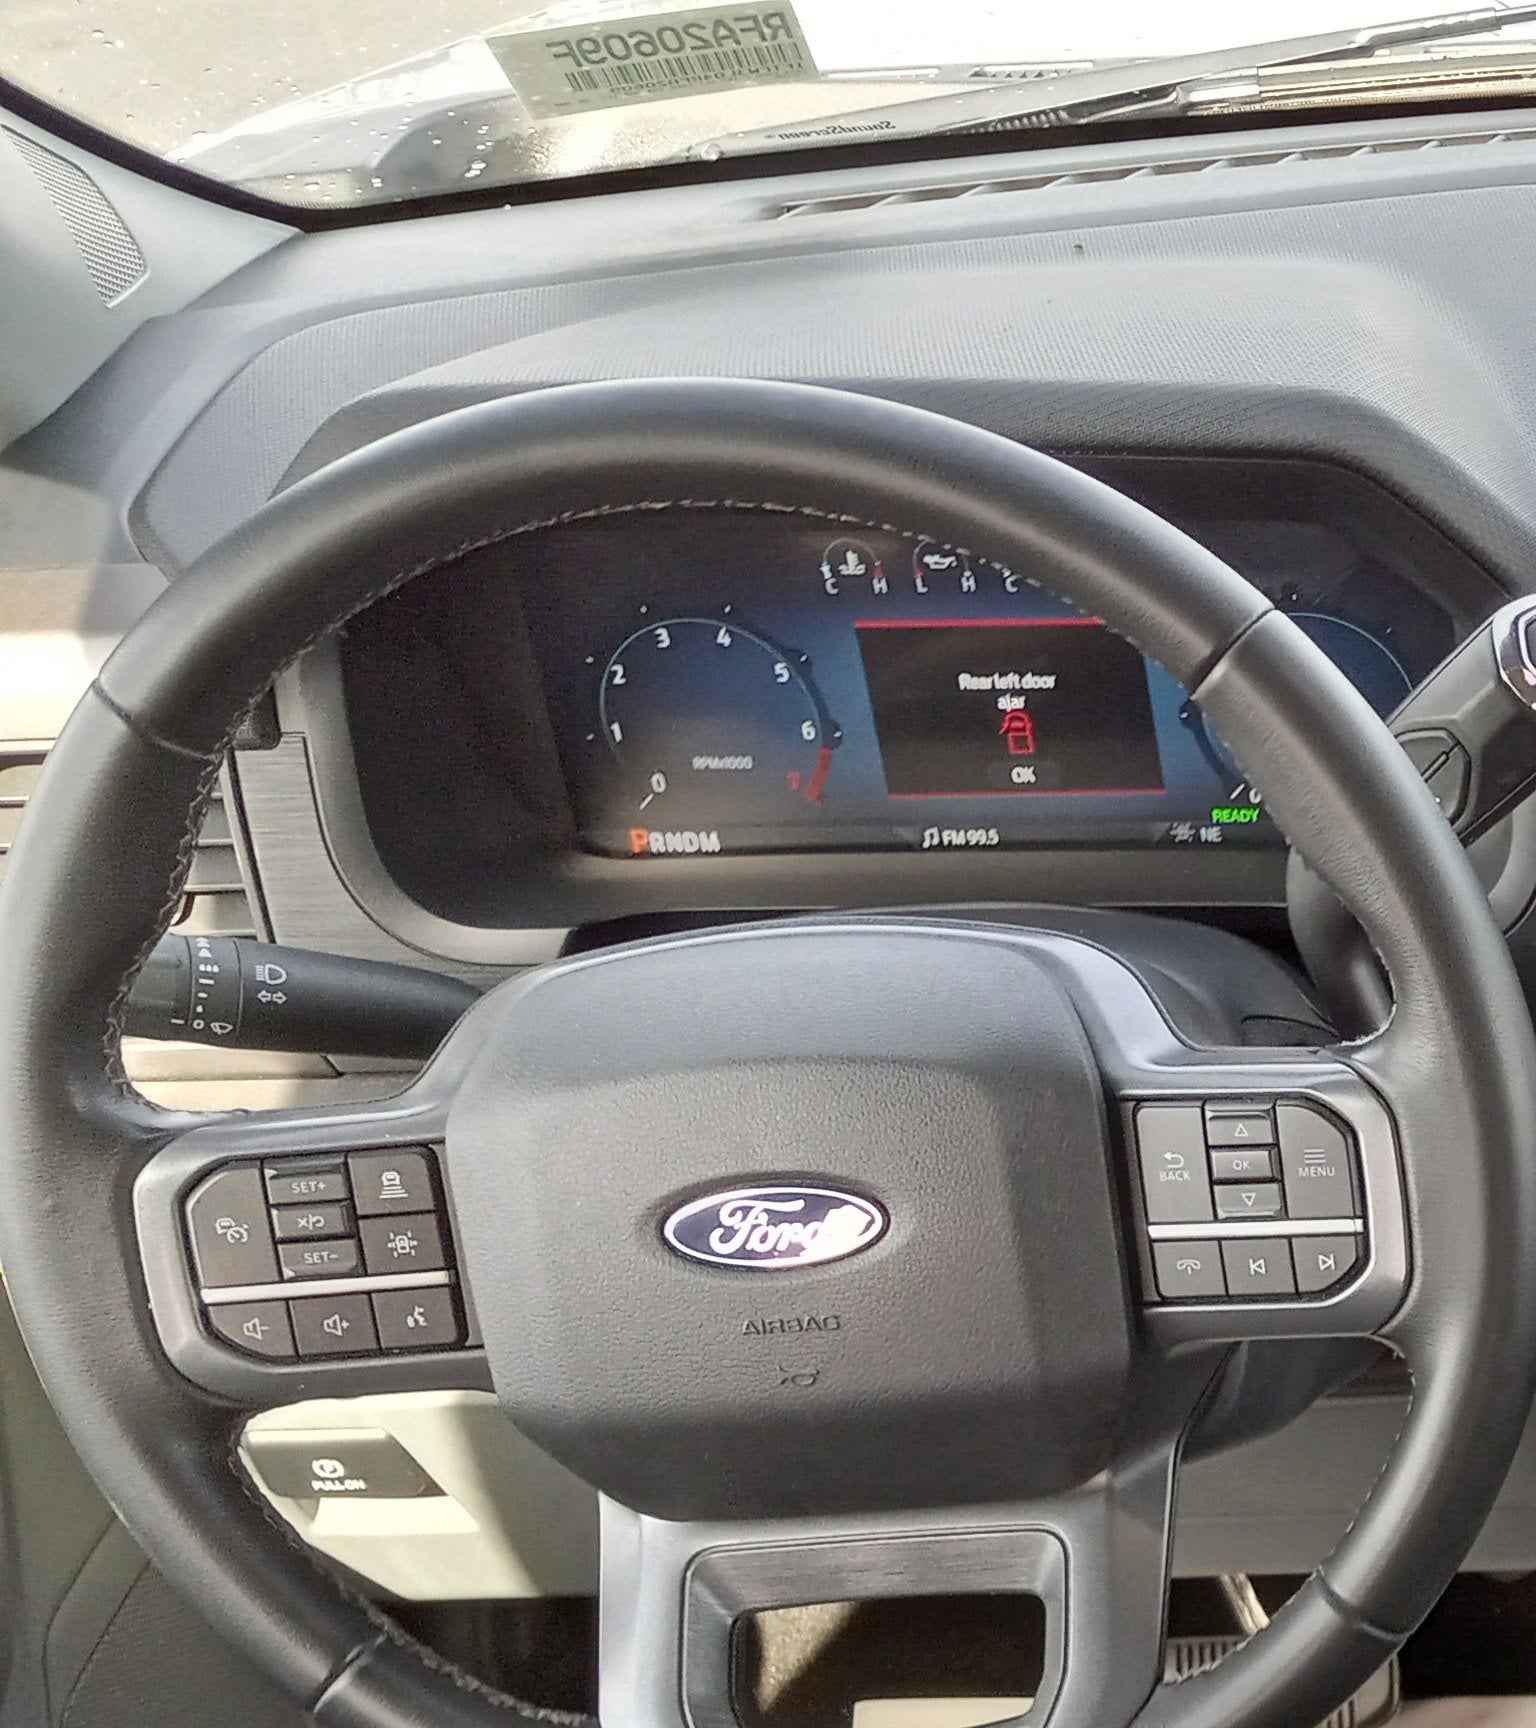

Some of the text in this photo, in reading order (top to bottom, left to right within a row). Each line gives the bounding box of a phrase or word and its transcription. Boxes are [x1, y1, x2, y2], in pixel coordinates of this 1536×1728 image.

[654, 627, 671, 648] 3
[716, 626, 732, 647] 4
[611, 664, 627, 685] 2
[774, 663, 790, 683] 5
[958, 671, 1056, 690] Rear left door
[997, 694, 1026, 711] ajar
[610, 722, 623, 742] 1
[801, 720, 816, 741] 6
[651, 771, 667, 793] 0
[1011, 766, 1036, 784] OK
[1211, 807, 1259, 823] READY
[943, 829, 999, 846] FM 99.5
[1232, 1160, 1250, 1170] OK
[1299, 1166, 1336, 1178] MENU
[1159, 1170, 1191, 1181] BACK
[291, 1181, 326, 1194] SET+
[742, 1315, 842, 1336] AIRBAG
